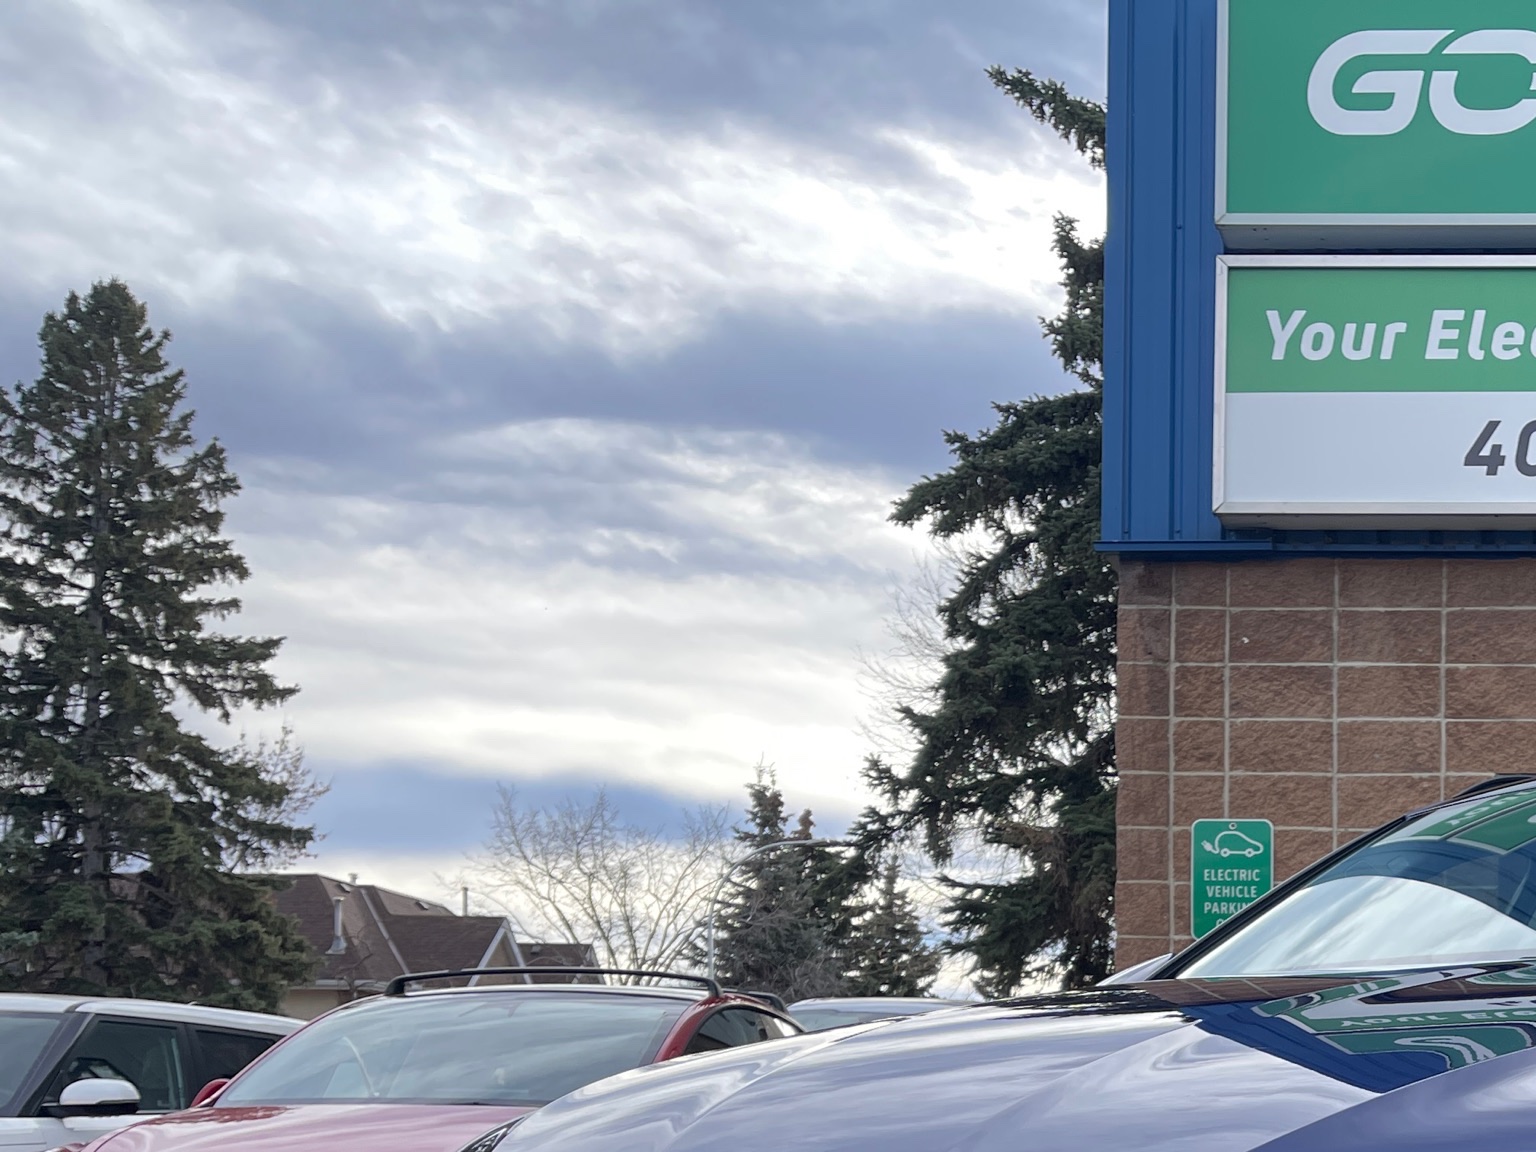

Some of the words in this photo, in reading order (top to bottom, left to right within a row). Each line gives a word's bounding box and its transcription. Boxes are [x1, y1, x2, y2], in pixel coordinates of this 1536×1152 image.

[1266, 311, 1406, 361] Your
[1203, 869, 1260, 881] ELECTRIC
[1206, 886, 1257, 898] VEHICLE
